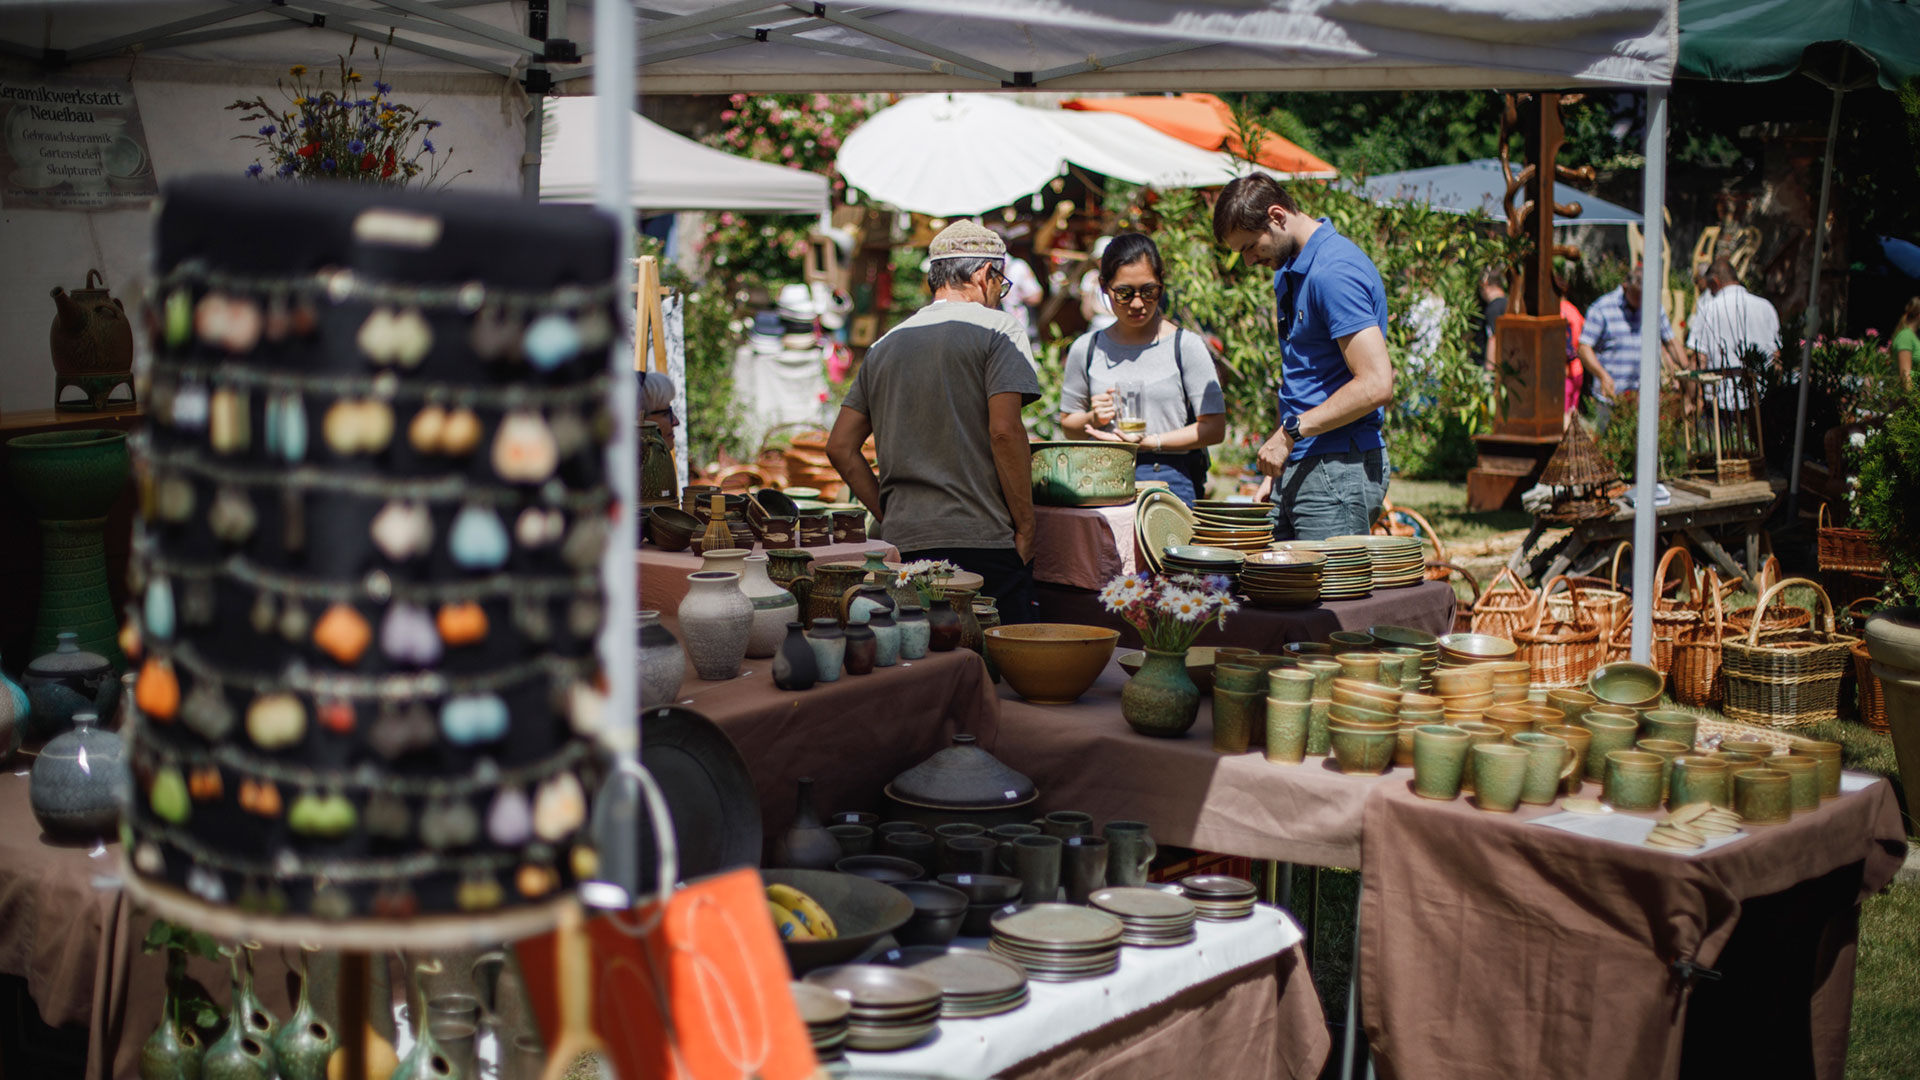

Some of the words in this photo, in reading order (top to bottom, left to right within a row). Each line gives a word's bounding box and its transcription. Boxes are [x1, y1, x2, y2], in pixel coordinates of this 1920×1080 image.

[22, 128, 113, 144] Gebrauchskeramik
[39, 147, 102, 160] Gartenstelen
[46, 164, 101, 178] Skulpturen
